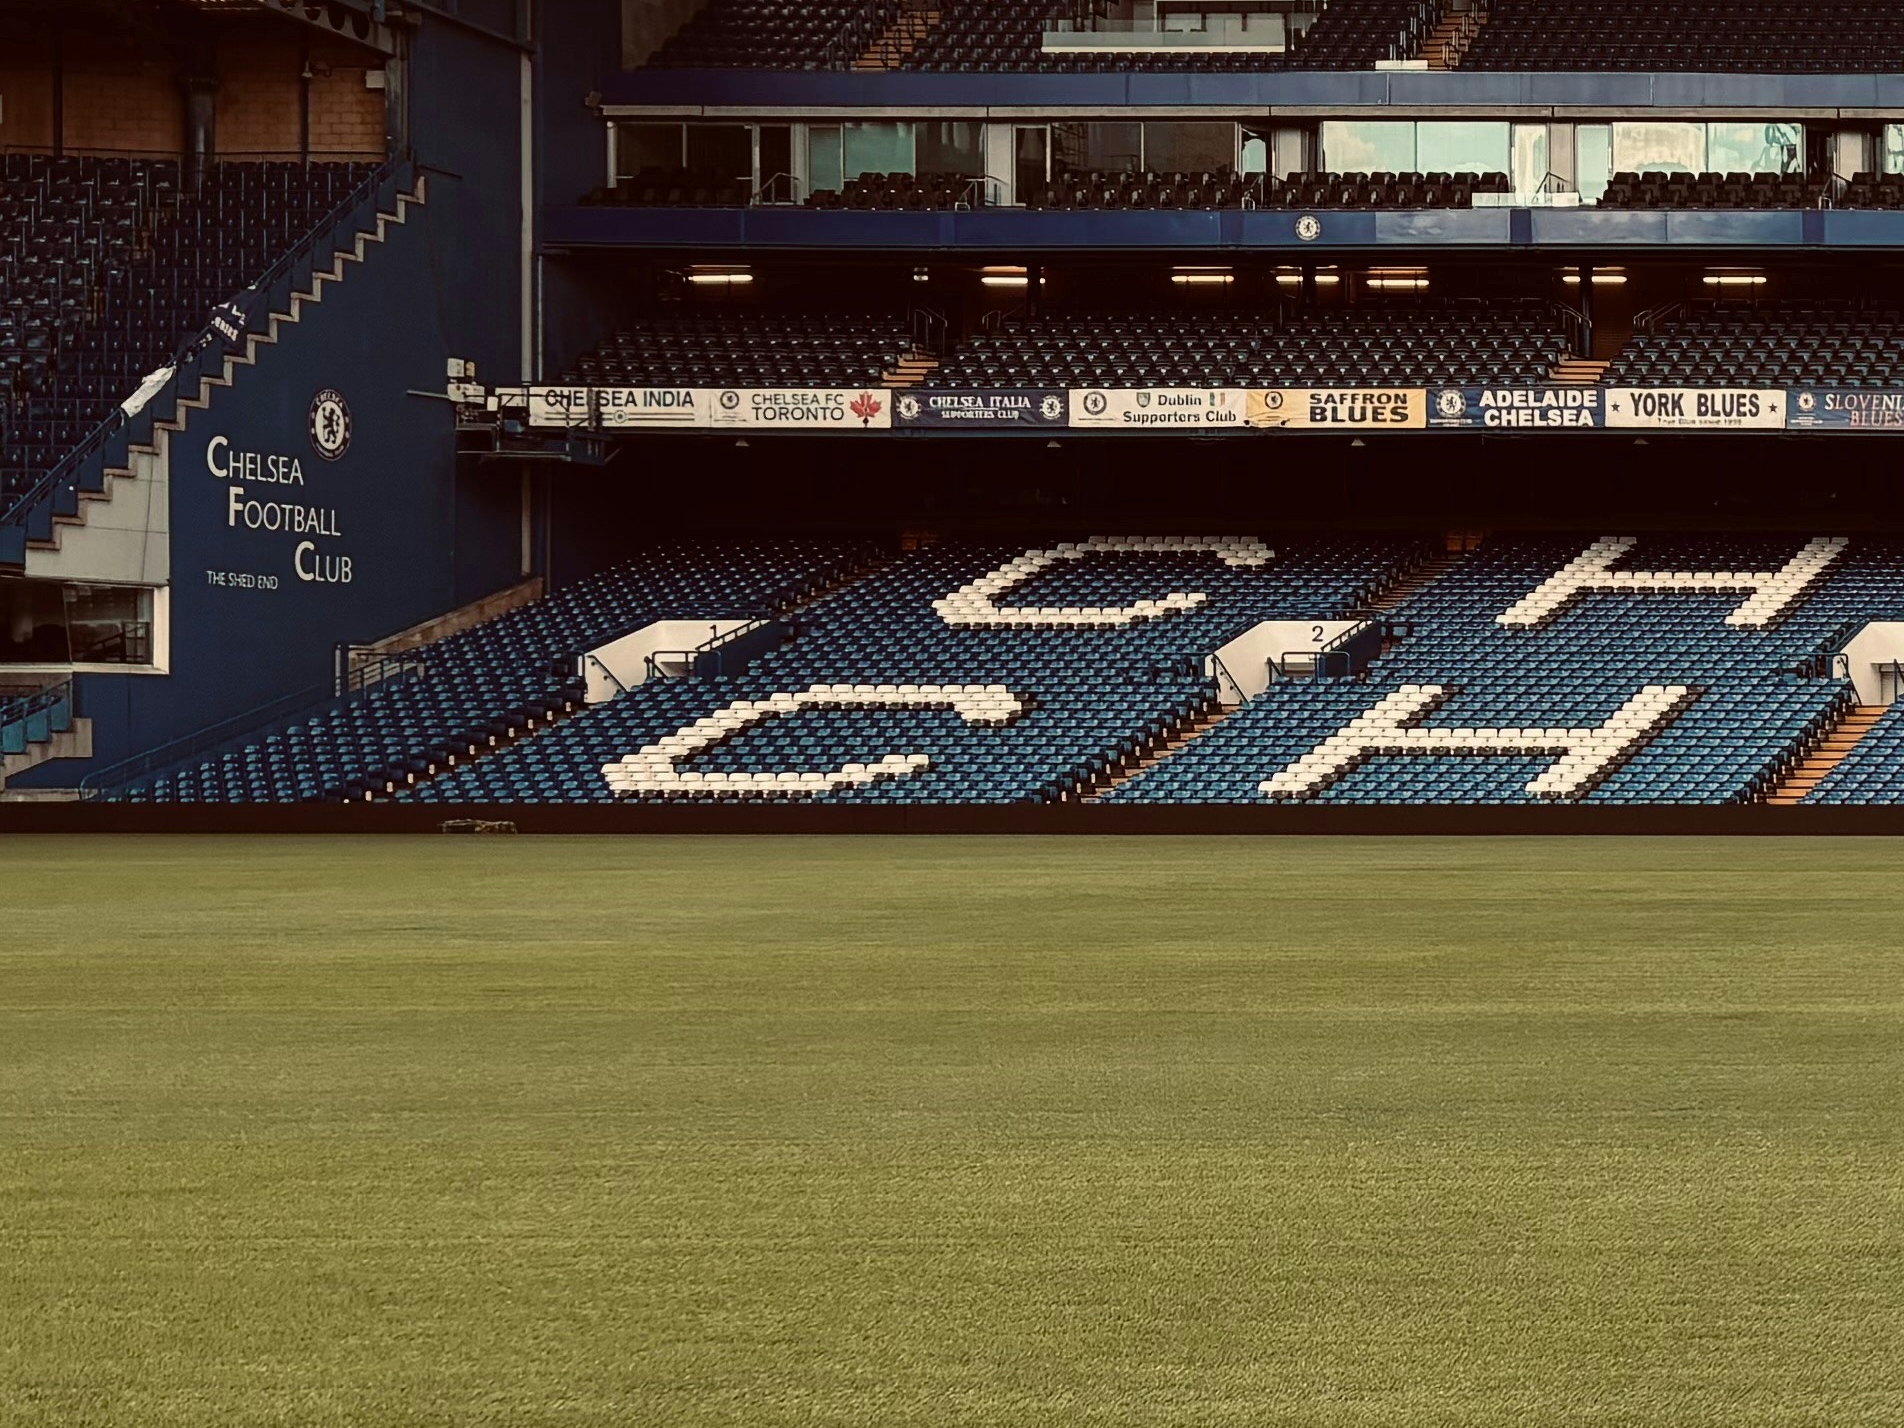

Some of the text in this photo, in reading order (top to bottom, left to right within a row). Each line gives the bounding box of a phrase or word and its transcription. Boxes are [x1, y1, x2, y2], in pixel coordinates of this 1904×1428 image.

[545, 389, 694, 407] CHESEA INDIA
[751, 393, 845, 406] CHELSEA FC
[929, 394, 1031, 409] CHELSEA ITALIA
[1157, 393, 1202, 406] Dublin
[1309, 392, 1408, 406] SAFFRON
[1478, 390, 1597, 407] ADELAIDE
[1630, 392, 1760, 418] YORK BLUES
[751, 406, 845, 422] TORONTO
[1123, 410, 1236, 425] Supporters Club
[1309, 406, 1409, 423] BLUES
[1483, 409, 1594, 427] CHELSEA
[1850, 410, 1904, 428] BLUES
[207, 435, 304, 486] CHELSEA
[228, 486, 342, 537] FOOTBALL
[295, 541, 353, 584] CLUB
[207, 571, 279, 590] THE SHED END
[1312, 625, 1324, 642] 2
